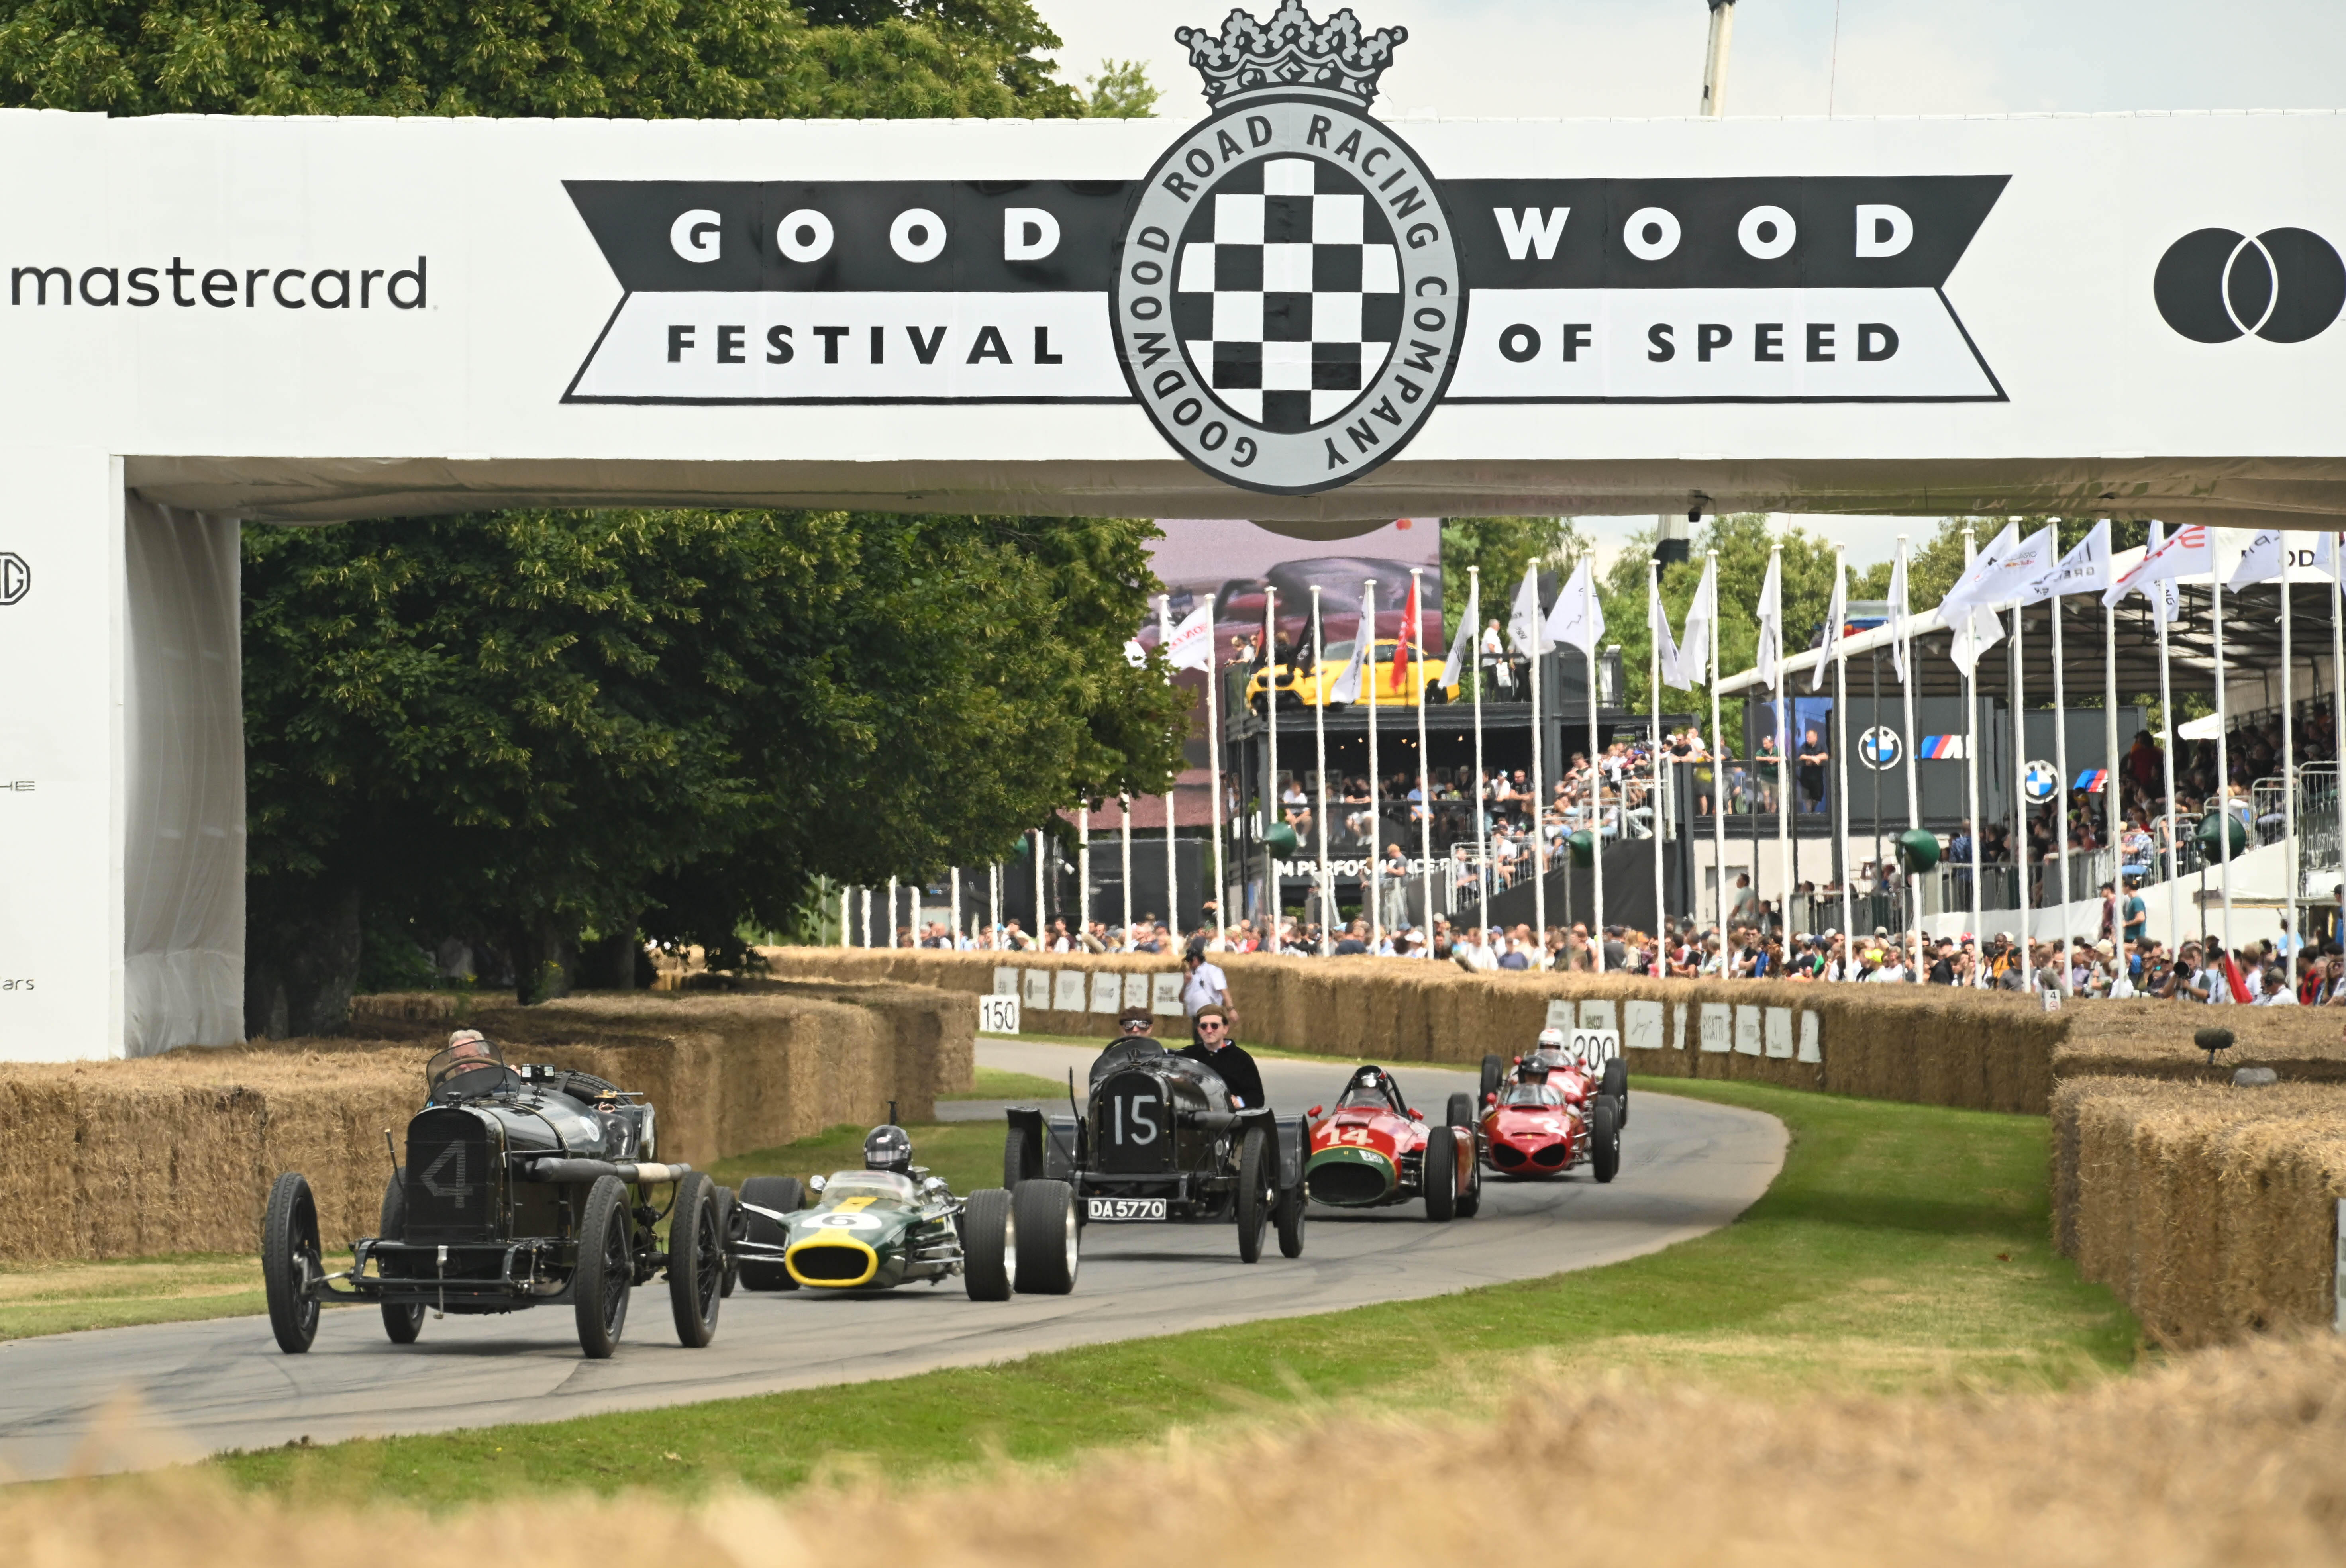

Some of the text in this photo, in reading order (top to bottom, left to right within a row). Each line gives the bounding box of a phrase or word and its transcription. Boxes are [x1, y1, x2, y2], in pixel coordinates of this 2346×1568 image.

[669, 204, 1914, 263] GOOD WOOD
[11, 255, 428, 309] mastercard
[1163, 114, 1448, 470] ROAD RACING COMPANY
[667, 323, 1899, 365] FESTIVAL OF SPEED
[1130, 225, 1257, 468] GOODWOOD
[983, 1001, 1015, 1030] 150
[1574, 1035, 1615, 1070] 200
[1114, 1095, 1158, 1145] 15
[1326, 1128, 1374, 1146] 14
[420, 1139, 473, 1209] 4
[822, 1215, 857, 1226] 6
[1090, 1200, 1164, 1218] DA 5770
